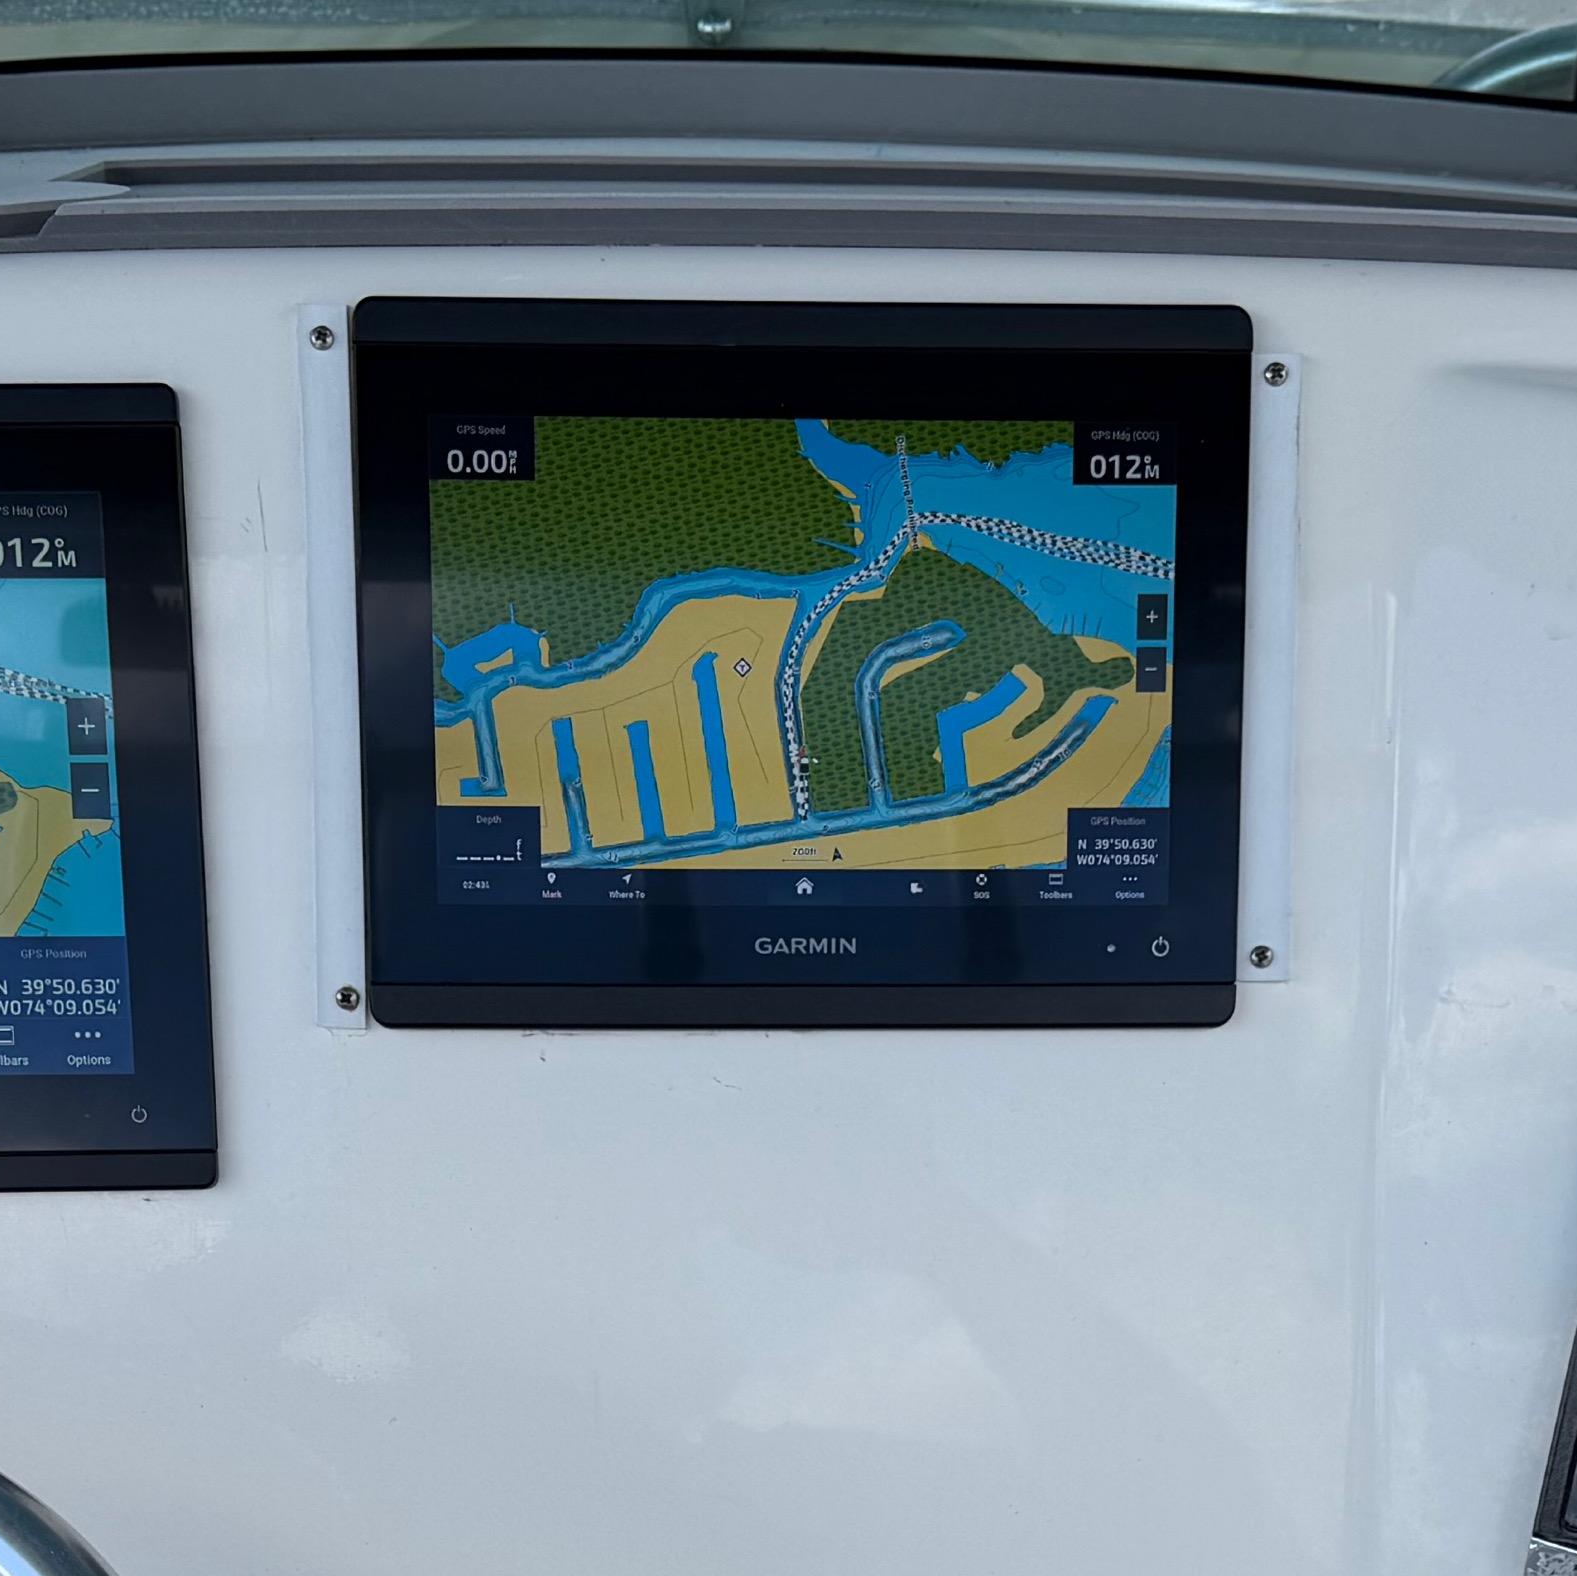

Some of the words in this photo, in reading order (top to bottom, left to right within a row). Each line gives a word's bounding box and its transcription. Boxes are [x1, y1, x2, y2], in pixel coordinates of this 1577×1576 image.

[456, 425, 476, 434] GPS
[478, 425, 506, 435] Speed
[447, 449, 507, 473] 0.00
[476, 815, 502, 825] Depth
[1078, 839, 1087, 850] N
[542, 890, 562, 899] Mark
[609, 890, 633, 899] Where
[973, 891, 990, 899] SOS
[1115, 890, 1145, 900] Options
[754, 937, 857, 955] GARMIN
[21, 949, 43, 959] GPS
[45, 948, 87, 960] Position
[67, 1054, 111, 1068] Options
